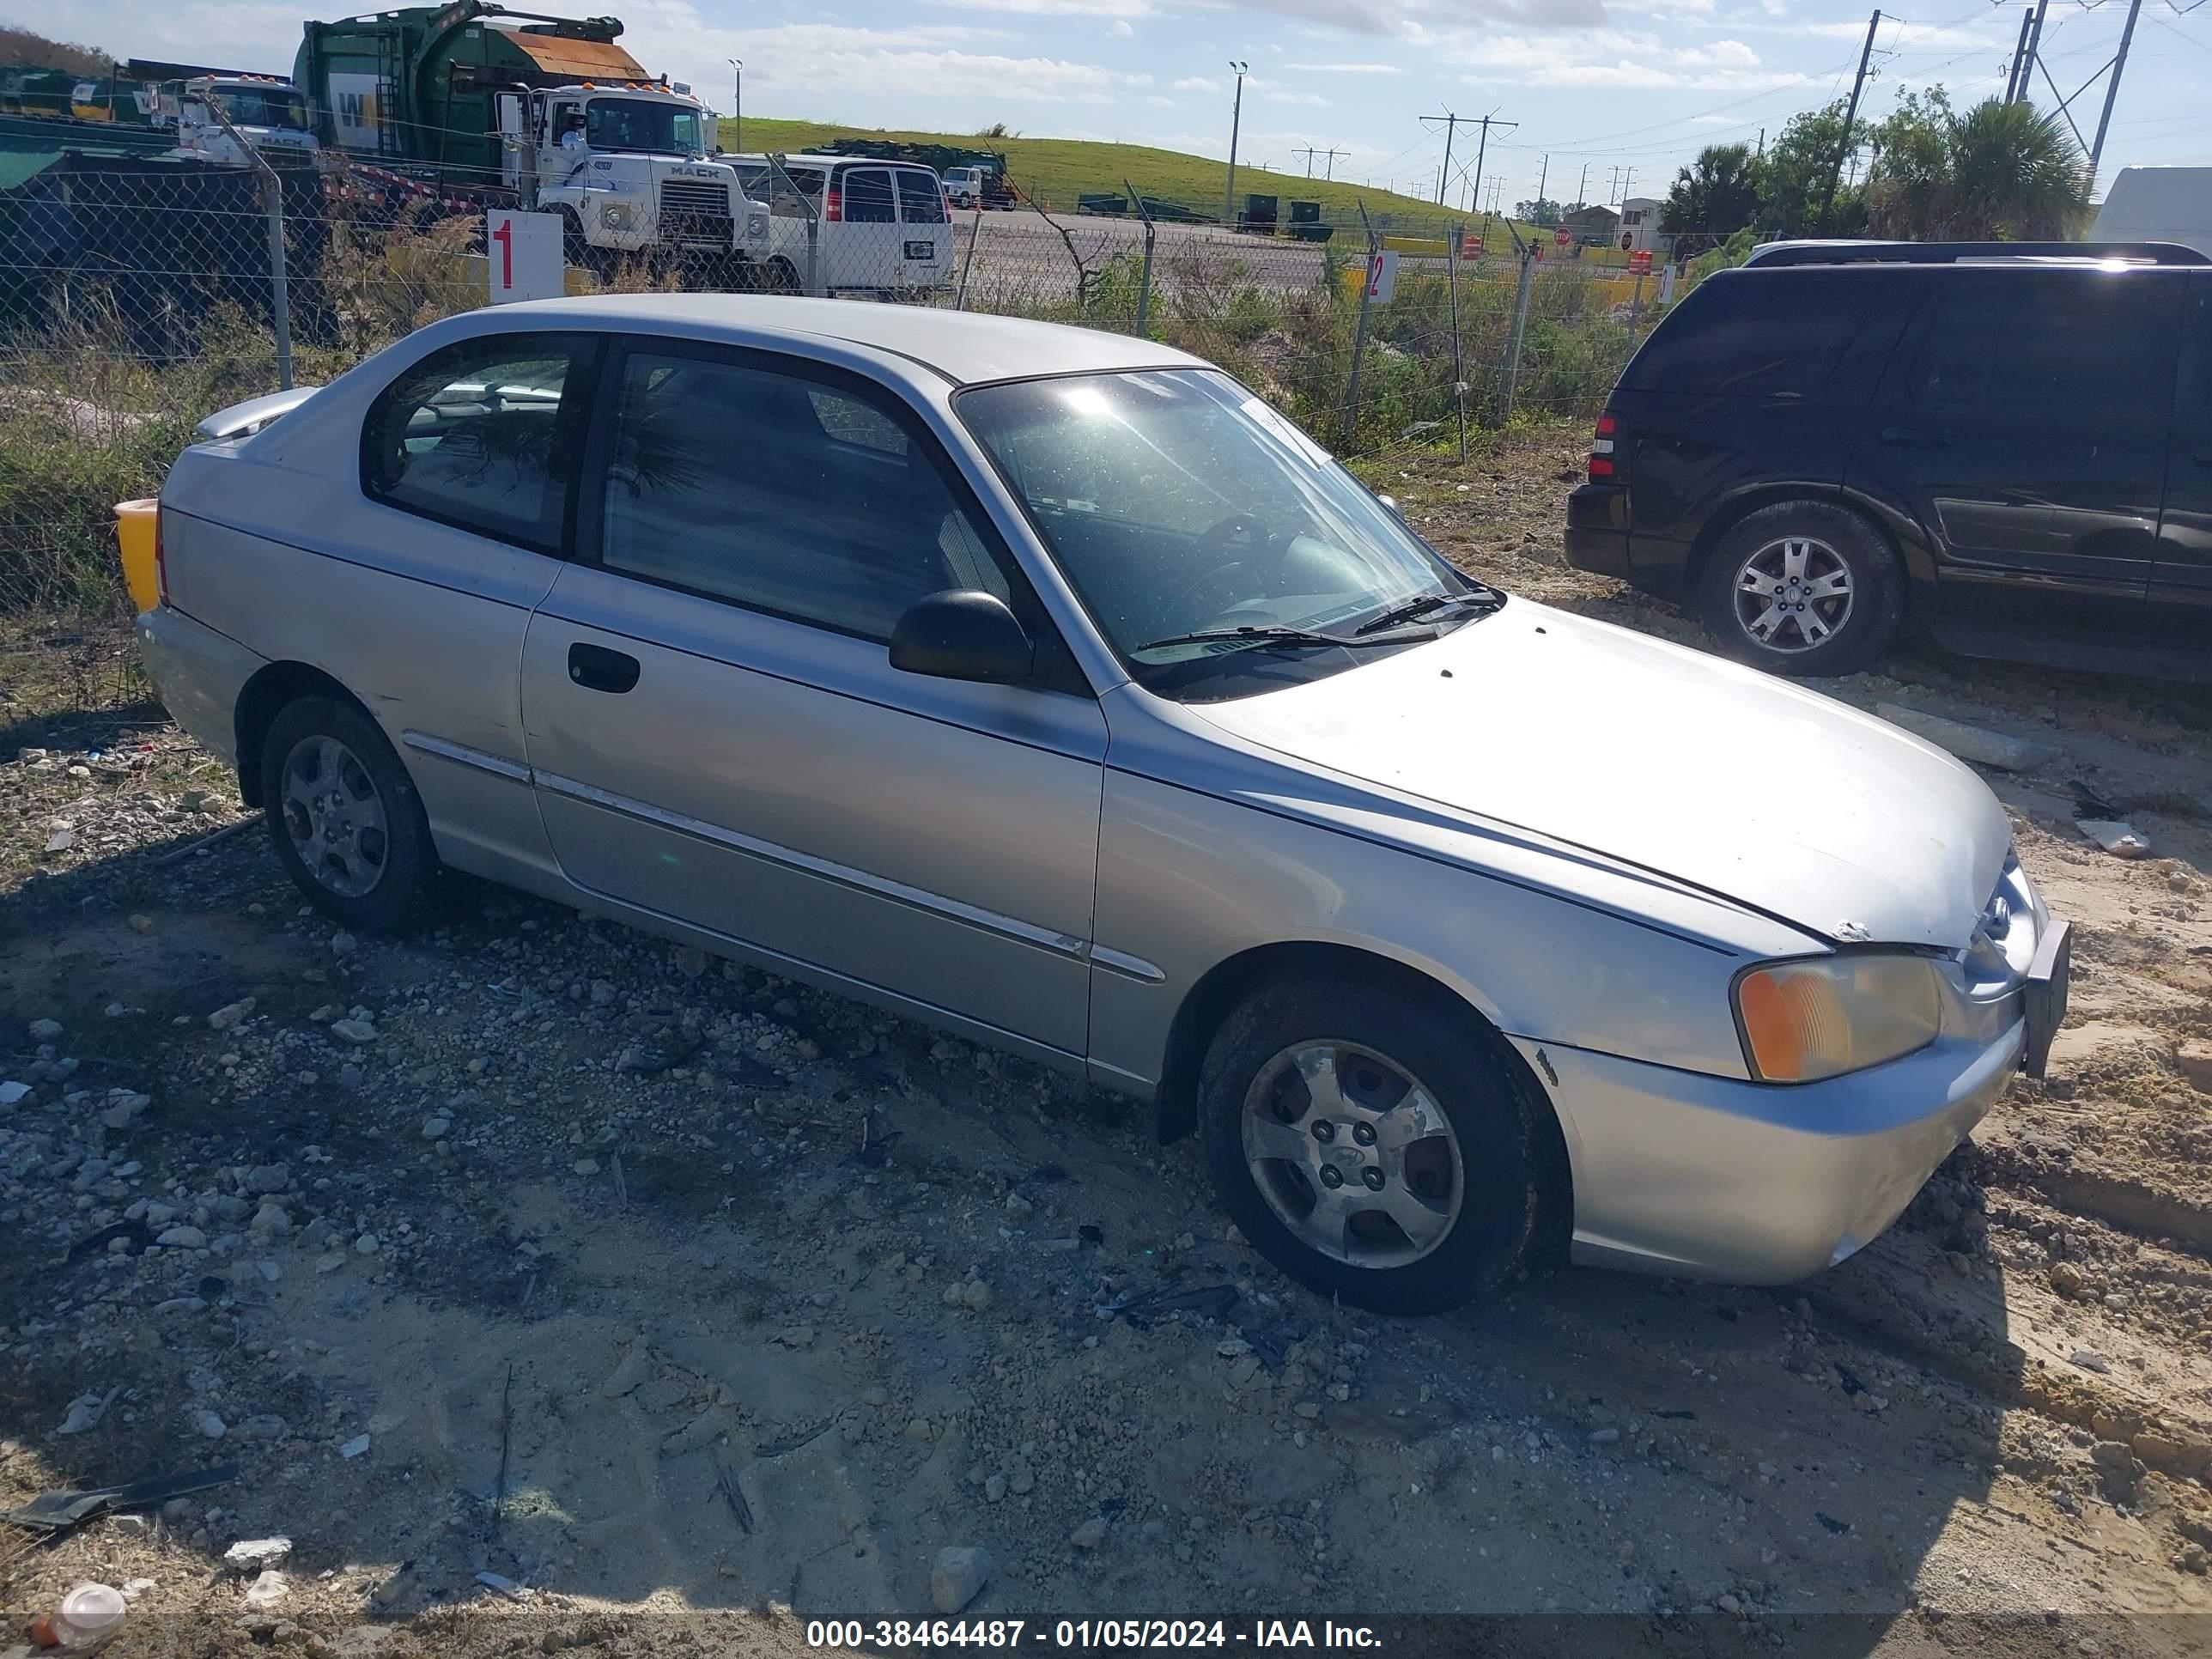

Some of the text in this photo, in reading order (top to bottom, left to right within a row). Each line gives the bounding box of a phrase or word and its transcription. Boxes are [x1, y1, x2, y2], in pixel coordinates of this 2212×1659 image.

[338, 94, 383, 128] WM
[262, 137, 302, 146] MACK
[671, 167, 720, 179] MACK
[493, 219, 512, 289] 1
[1370, 256, 1383, 296] 2
